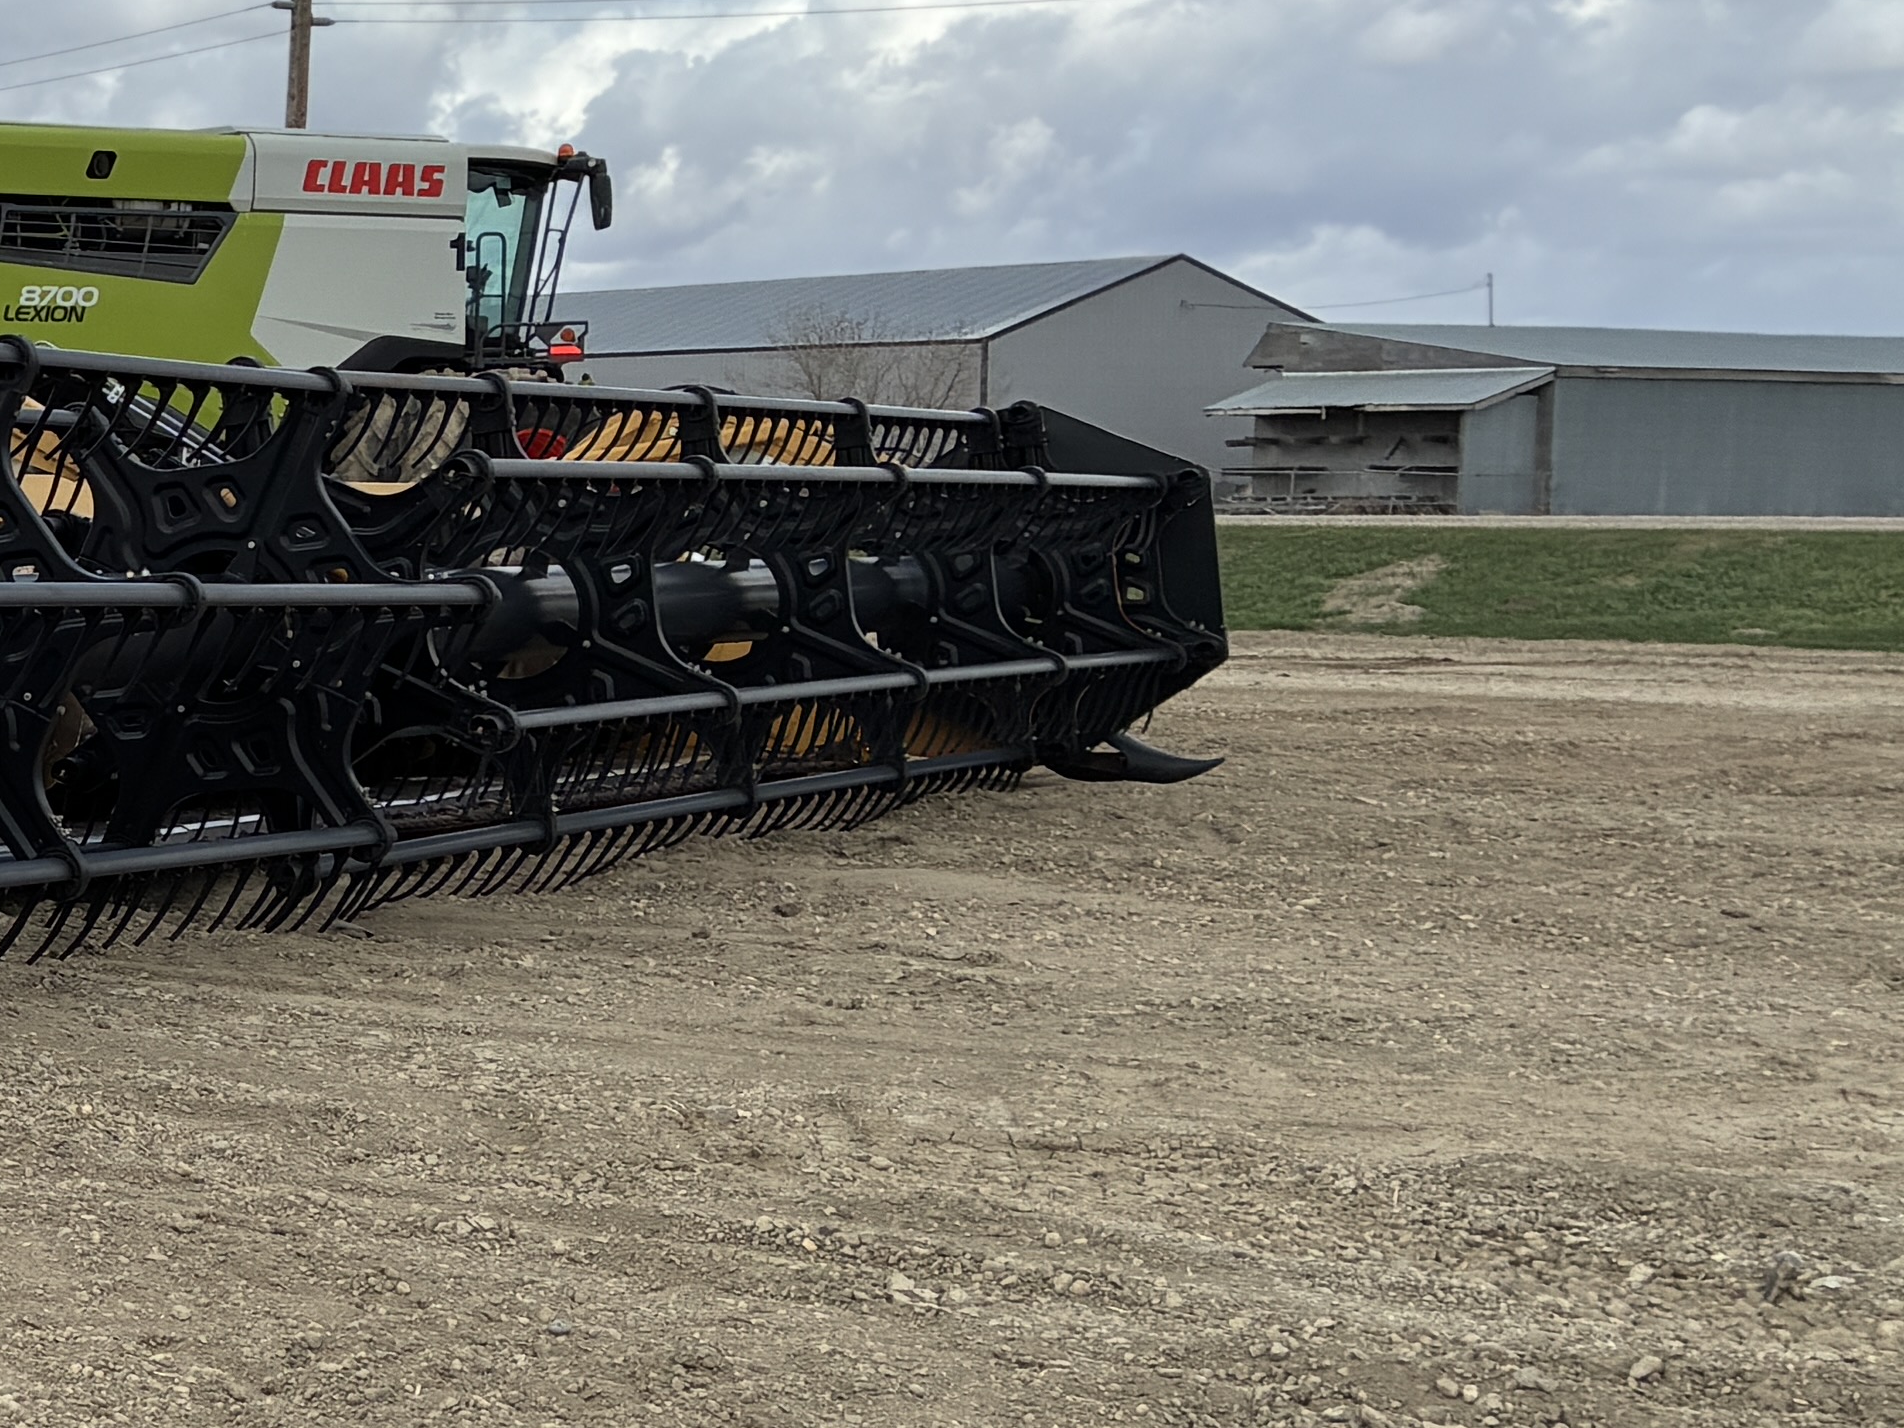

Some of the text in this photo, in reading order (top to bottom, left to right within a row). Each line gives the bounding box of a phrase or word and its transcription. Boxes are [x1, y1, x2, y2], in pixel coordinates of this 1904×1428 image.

[302, 159, 445, 198] CLAAS
[449, 232, 466, 271] 1
[19, 285, 100, 308] 8700
[3, 304, 86, 323] LEXION
